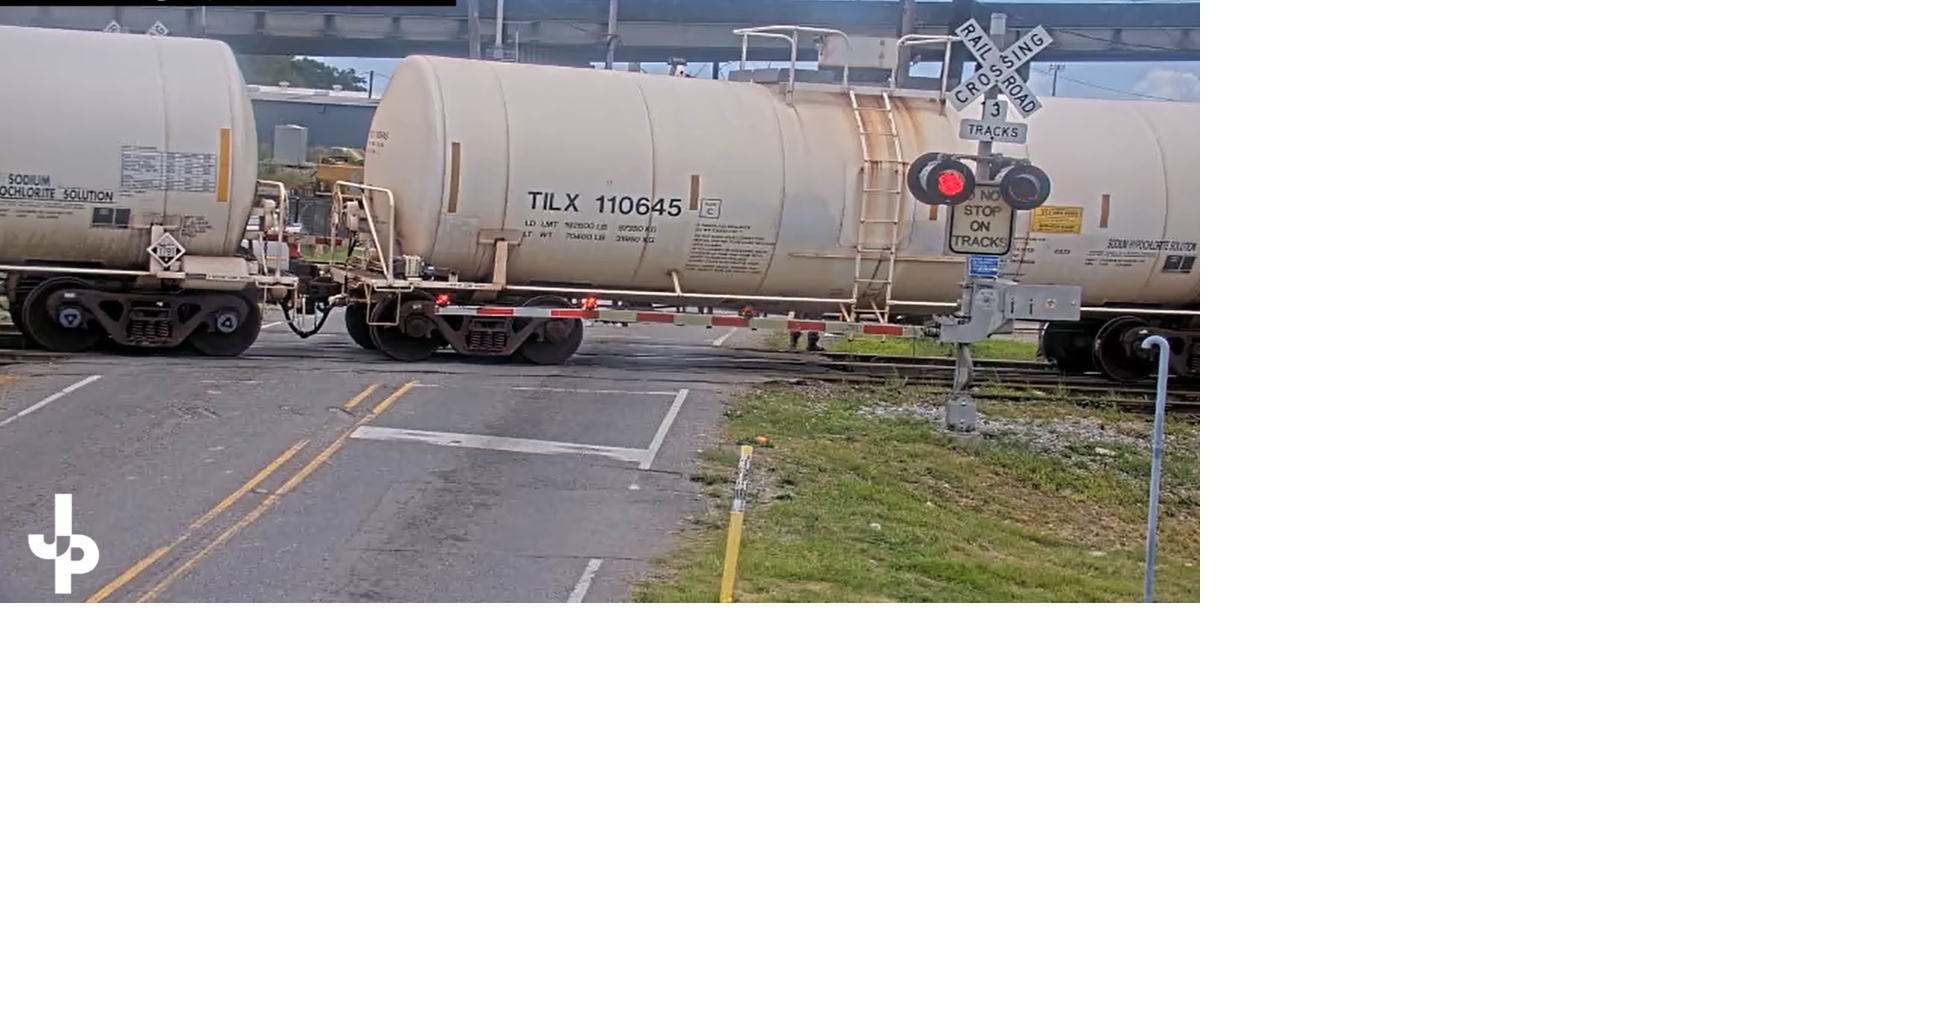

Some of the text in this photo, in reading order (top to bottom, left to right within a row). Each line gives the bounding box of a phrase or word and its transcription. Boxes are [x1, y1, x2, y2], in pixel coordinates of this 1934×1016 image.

[954, 33, 1044, 104] CROSSING
[960, 23, 1037, 113] RAIL ROAD
[990, 102, 1001, 117] 3
[968, 124, 1018, 138] TRACKS
[8, 173, 51, 187] SODIUM
[63, 189, 114, 201] SOLUTION
[980, 189, 1001, 202] NO
[528, 191, 682, 217] TILX 110645
[964, 205, 1002, 218] STOP
[540, 220, 559, 228] LMT
[596, 223, 608, 231] LB
[970, 220, 991, 232] ON
[522, 230, 533, 238] LT
[953, 235, 1008, 249] TRACKS
